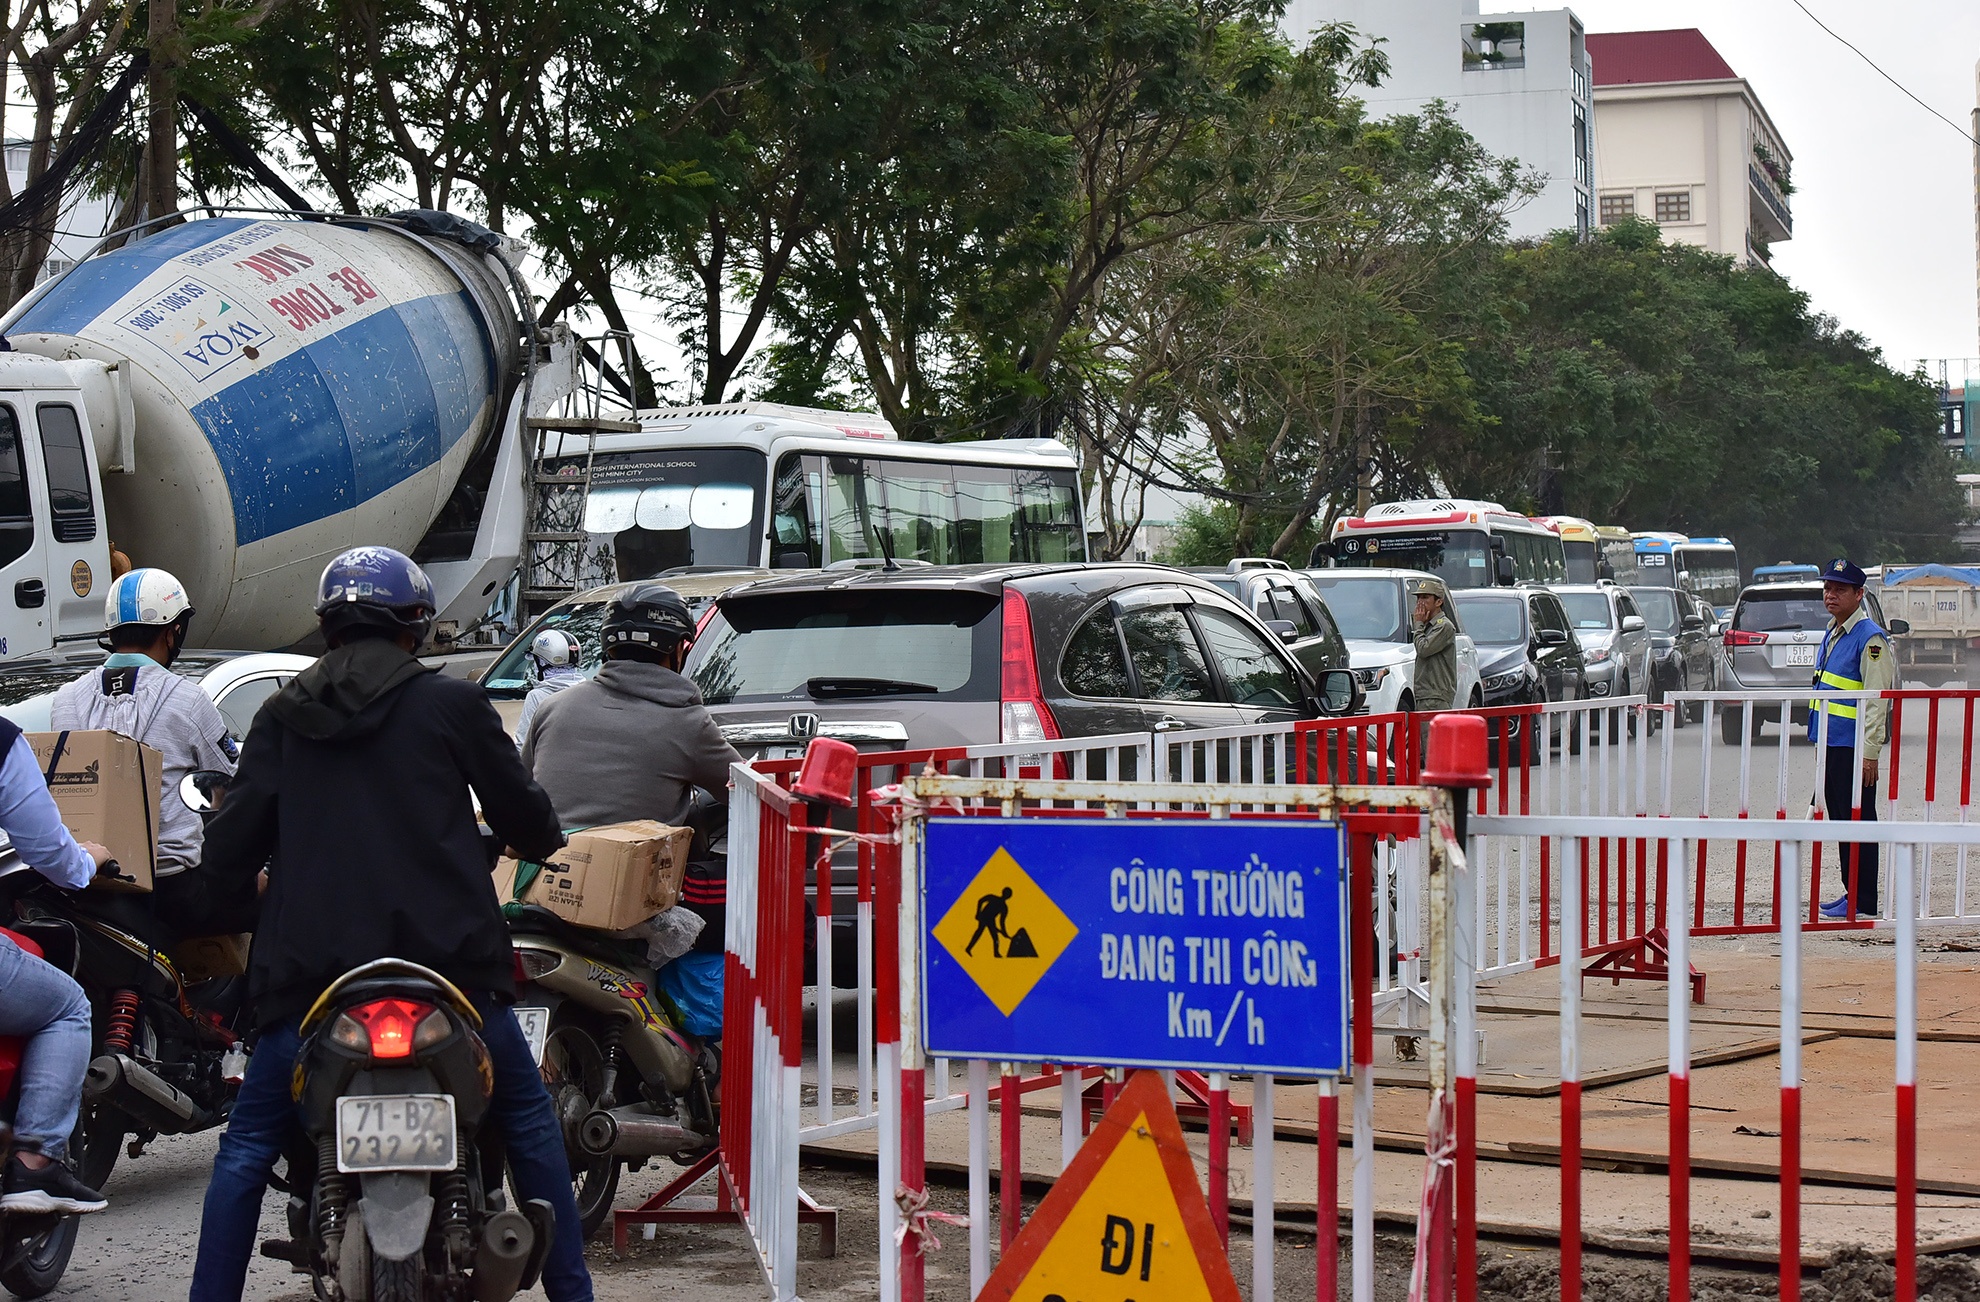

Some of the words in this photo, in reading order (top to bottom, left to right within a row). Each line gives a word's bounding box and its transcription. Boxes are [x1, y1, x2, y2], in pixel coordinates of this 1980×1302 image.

[179, 282, 207, 299] ISO
[328, 266, 377, 306] BE
[156, 292, 192, 313] 9001
[266, 282, 345, 332] TONG
[129, 310, 165, 331] 2008
[182, 320, 262, 366] WQA
[581, 466, 608, 474] BITISH
[608, 462, 665, 471] INTERNATIONAL
[626, 469, 643, 477] CITY
[1346, 542, 1357, 551] 41
[1787, 655, 1813, 664] 446.87
[1792, 646, 1808, 656] 51F
[1110, 857, 1184, 916] CÔNG
[1191, 853, 1305, 918] TRƯỜNG
[1099, 933, 1175, 983] ĐANG
[1184, 936, 1231, 985] THI
[1243, 930, 1317, 987] CÔNG
[587, 962, 630, 984] Wave
[1167, 990, 1266, 1047] Km/h
[356, 1101, 437, 1132] 71-B2
[1101, 1214, 1154, 1282] ĐI
